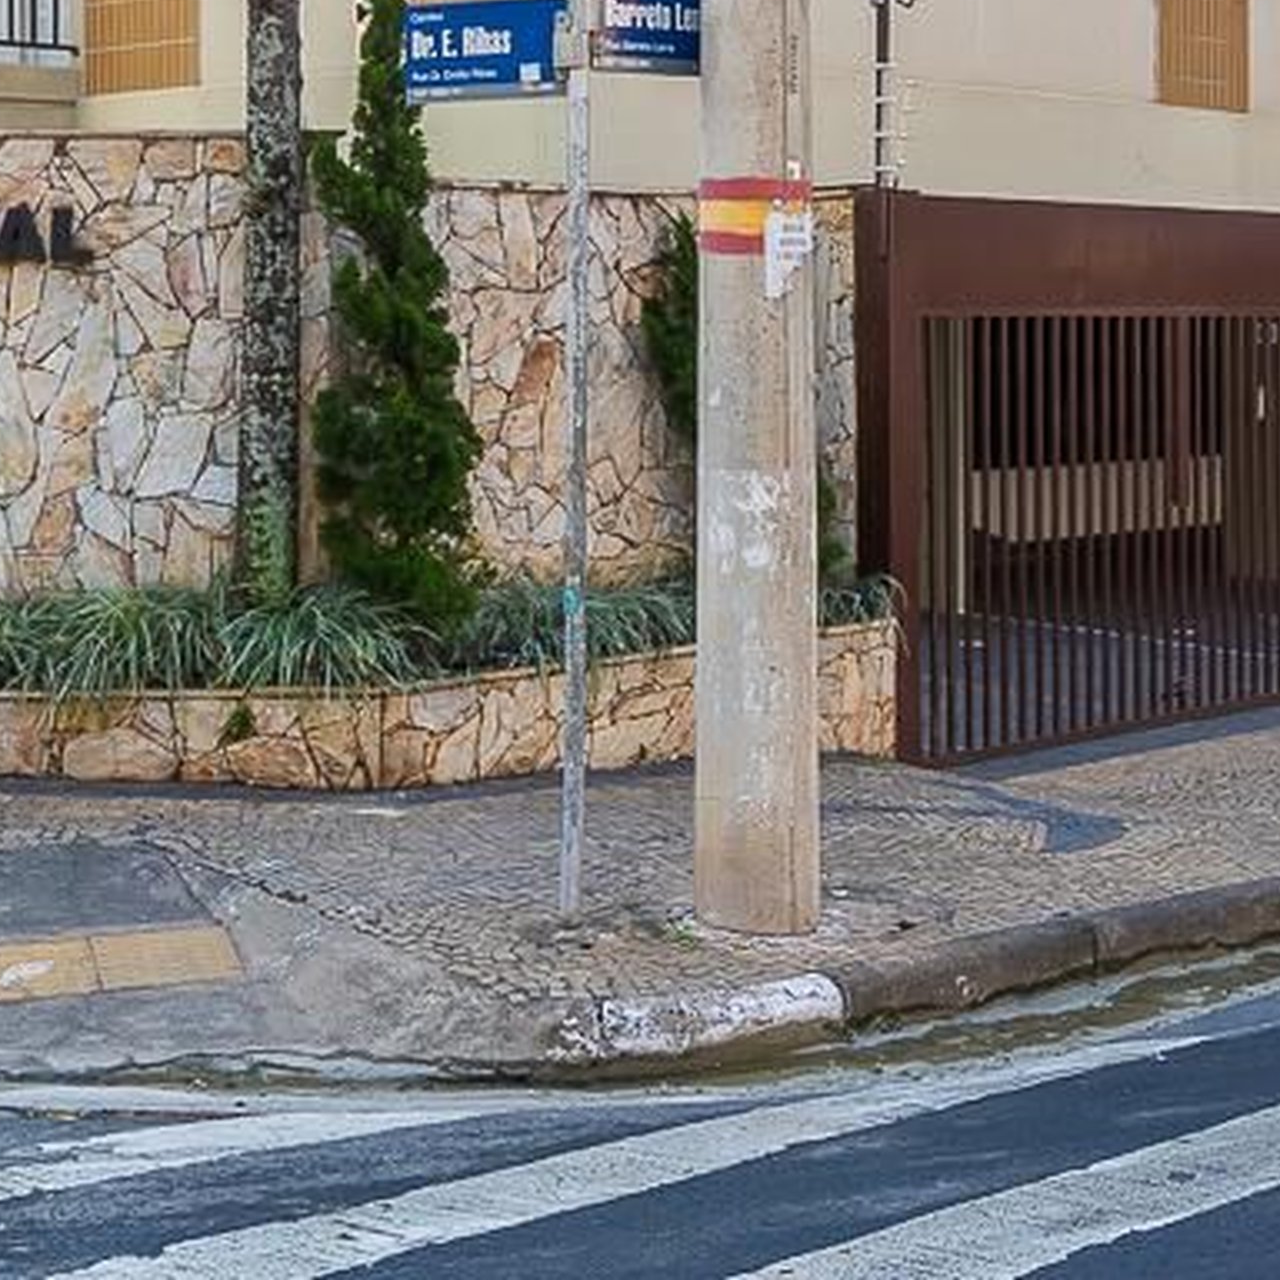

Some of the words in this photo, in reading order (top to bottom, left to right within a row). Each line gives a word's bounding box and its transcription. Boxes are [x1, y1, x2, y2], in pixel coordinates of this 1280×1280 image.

[411, 30, 438, 61] Dr.
[441, 28, 459, 59] E.
[462, 26, 513, 57] Ribas
